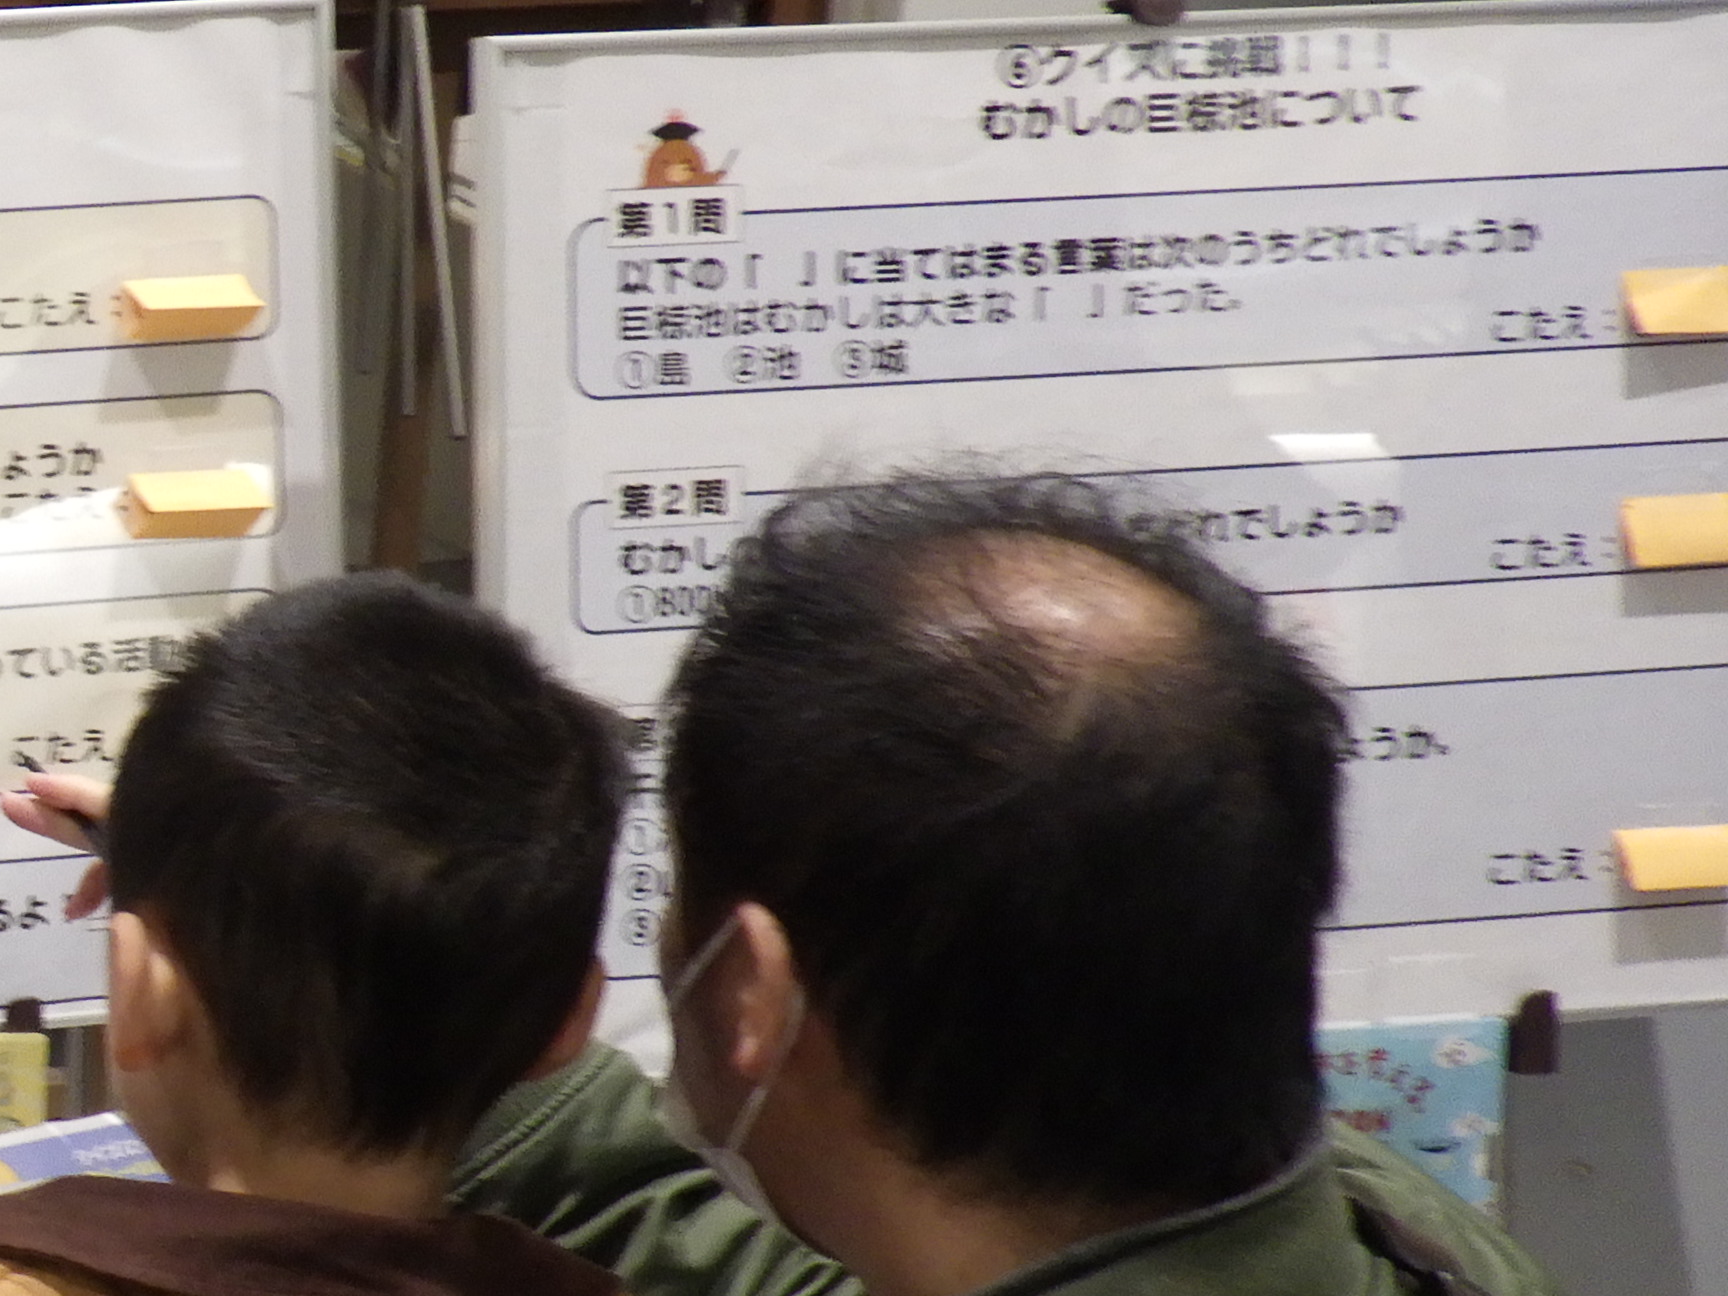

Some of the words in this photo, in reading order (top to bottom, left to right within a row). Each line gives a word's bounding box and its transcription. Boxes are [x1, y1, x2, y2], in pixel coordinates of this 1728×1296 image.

[981, 84, 1422, 141] むかしの巨椋池について
[616, 198, 726, 238] 第1問
[619, 478, 729, 519] 第2問
